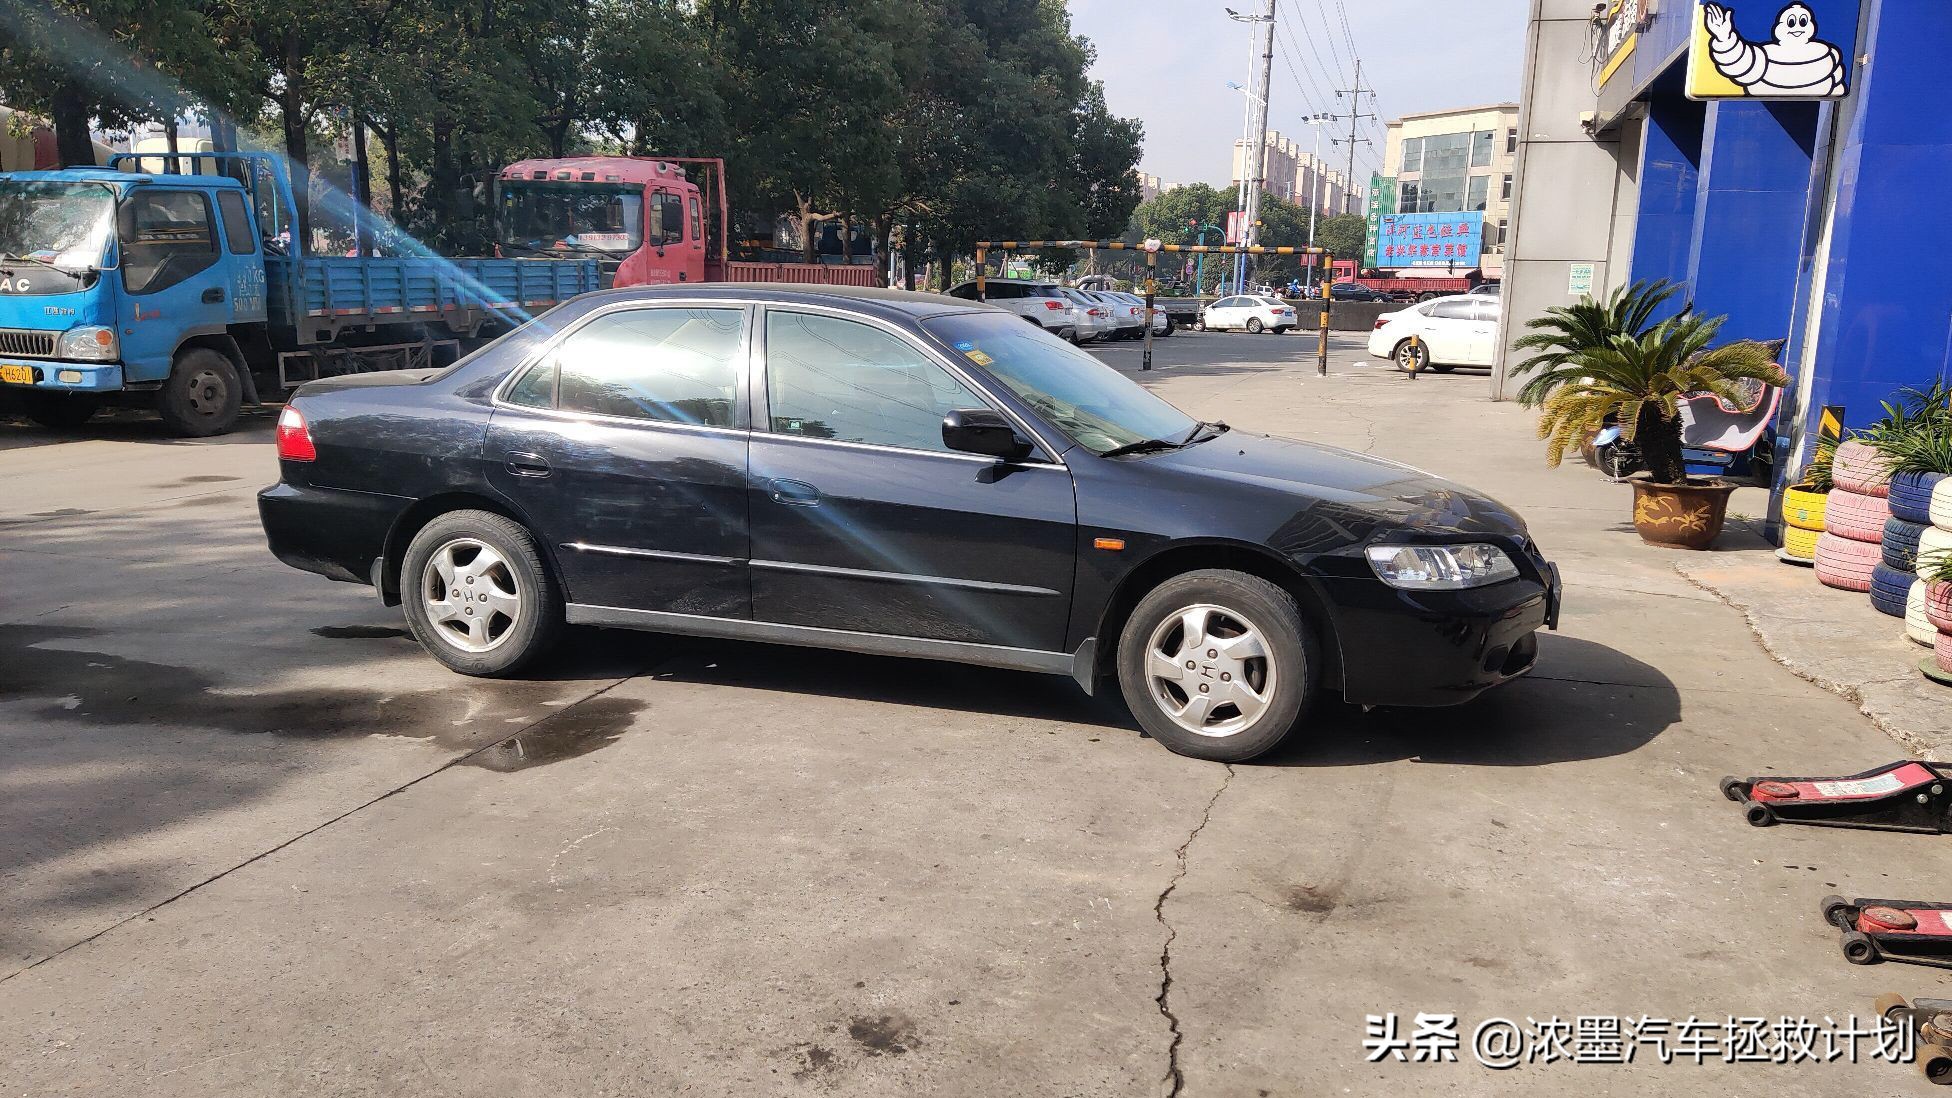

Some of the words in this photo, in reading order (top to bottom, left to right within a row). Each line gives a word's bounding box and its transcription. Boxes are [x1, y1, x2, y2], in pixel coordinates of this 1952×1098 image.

[1385, 223, 1470, 240] 洋河蓝色经典
